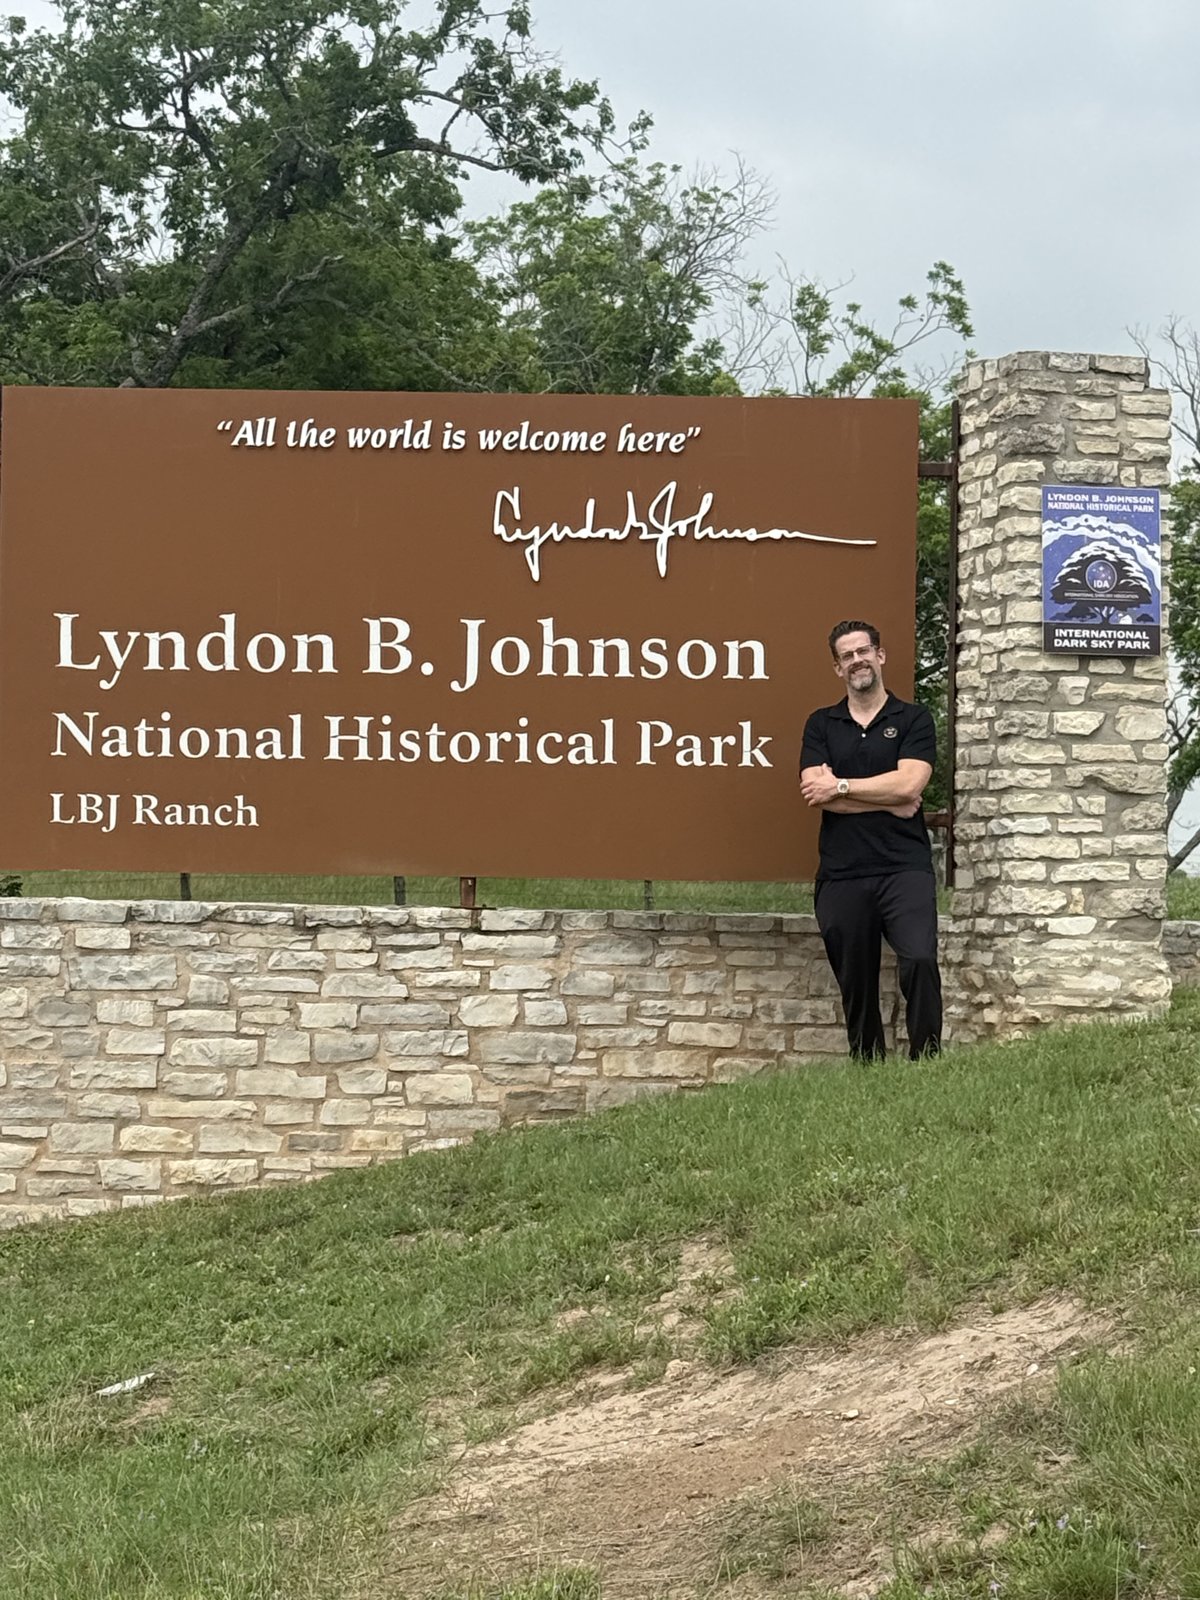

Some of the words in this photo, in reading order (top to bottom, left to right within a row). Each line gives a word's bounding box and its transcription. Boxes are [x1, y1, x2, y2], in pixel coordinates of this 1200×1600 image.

[287, 419, 336, 448] the
[347, 419, 432, 450] world
[443, 422, 465, 450] is
[478, 421, 606, 452] welcome
[1047, 493, 1089, 502] LYNDON
[1091, 494, 1103, 503] B.
[1105, 495, 1154, 504] JOHNSON
[1047, 501, 1084, 510] NATIONAL
[1086, 502, 1131, 512] HISTORICAL
[1133, 504, 1155, 512] PARK
[1093, 580, 1110, 588] IDA
[1054, 628, 1150, 639] INTERNATIONAL
[1053, 638, 1088, 648] DARK
[1090, 639, 1115, 649] SKY
[1117, 640, 1151, 649] PARK
[54, 612, 338, 690] Lyndon
[363, 617, 433, 676] B.
[451, 617, 769, 693] Johnson
[51, 711, 305, 760] National
[324, 714, 617, 765] Historical
[636, 720, 773, 768] Park
[50, 793, 120, 833] LBJ
[133, 794, 259, 827] Ranch
